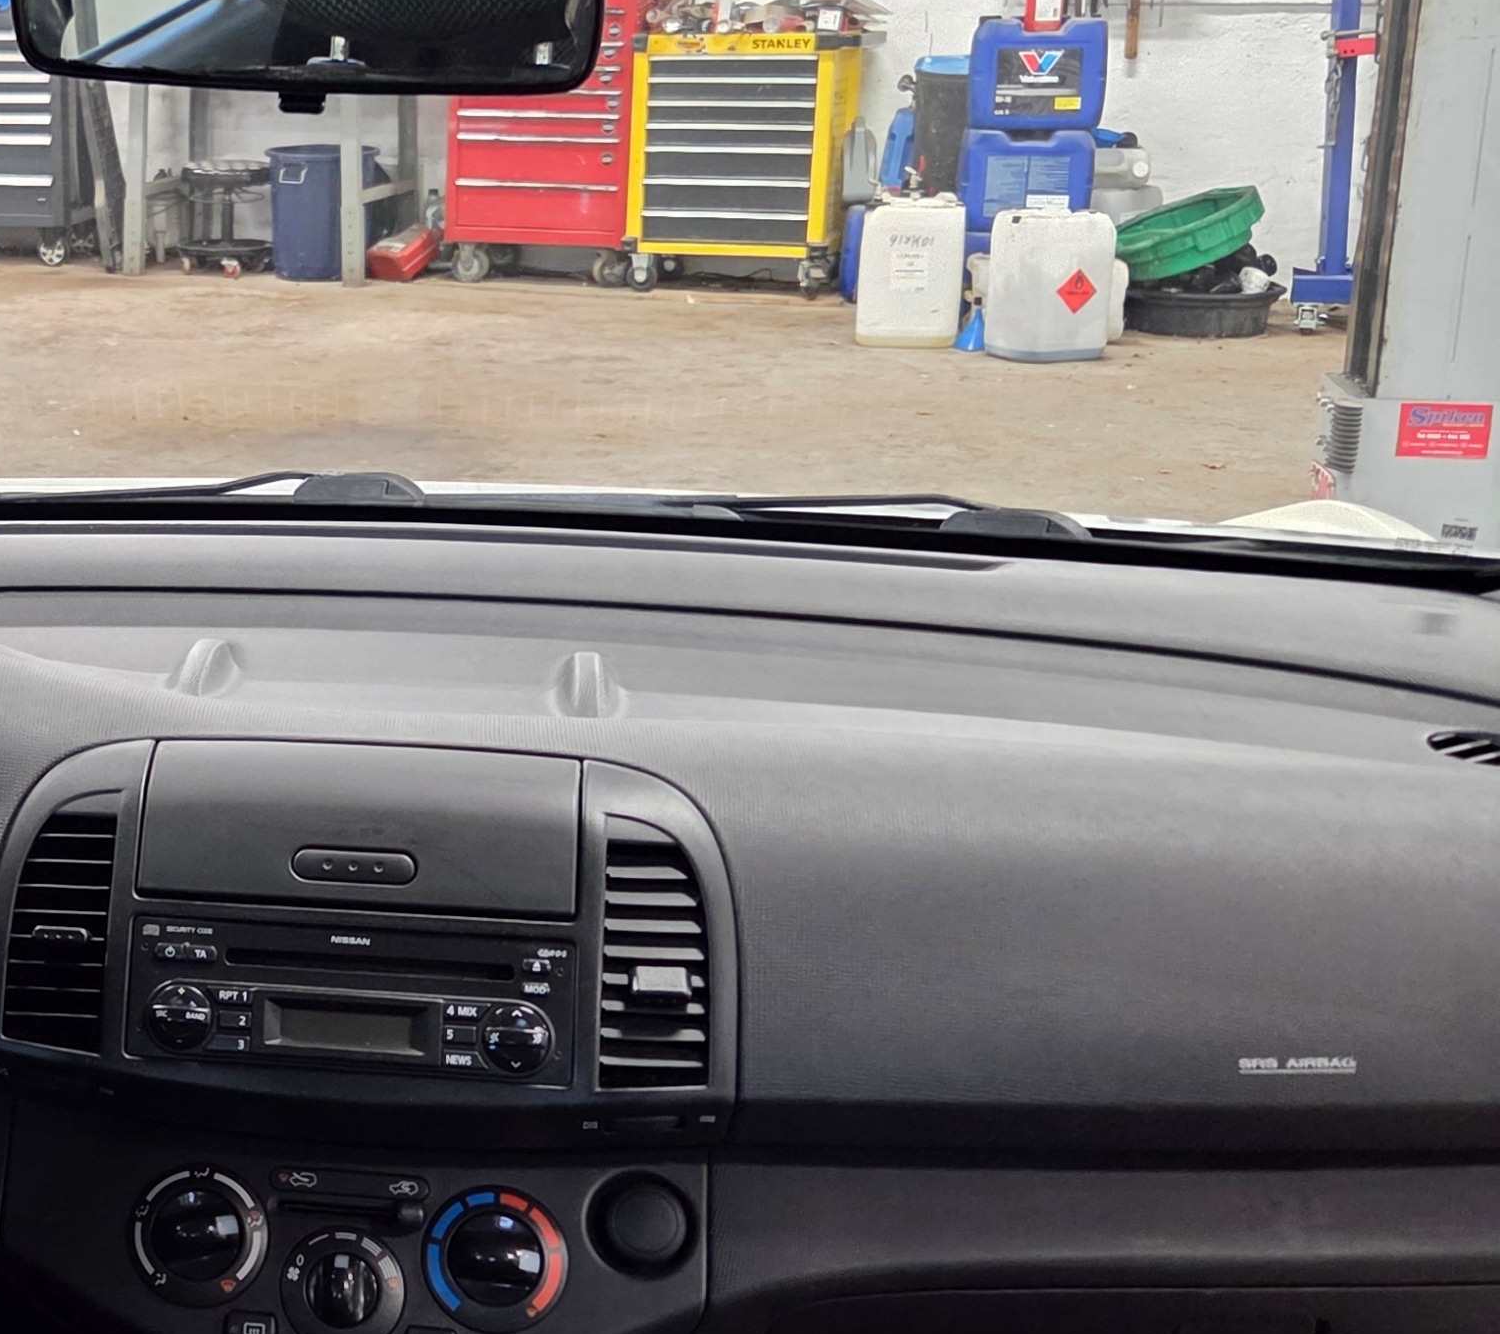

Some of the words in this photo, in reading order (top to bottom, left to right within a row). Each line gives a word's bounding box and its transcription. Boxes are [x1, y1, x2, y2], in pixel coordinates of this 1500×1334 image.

[751, 38, 811, 49] STANLEY
[330, 935, 371, 946] NISSAN
[194, 948, 207, 959] TA
[218, 989, 239, 1001] RPT
[241, 990, 248, 1002] 1
[185, 1011, 206, 1021] BAND
[446, 1004, 455, 1016] 4
[457, 1005, 478, 1017] MIX
[238, 1015, 247, 1026] 2
[446, 1028, 454, 1040] 5
[237, 1039, 245, 1050] 3
[445, 1054, 472, 1066] NEWS
[296, 1253, 304, 1267] 0
